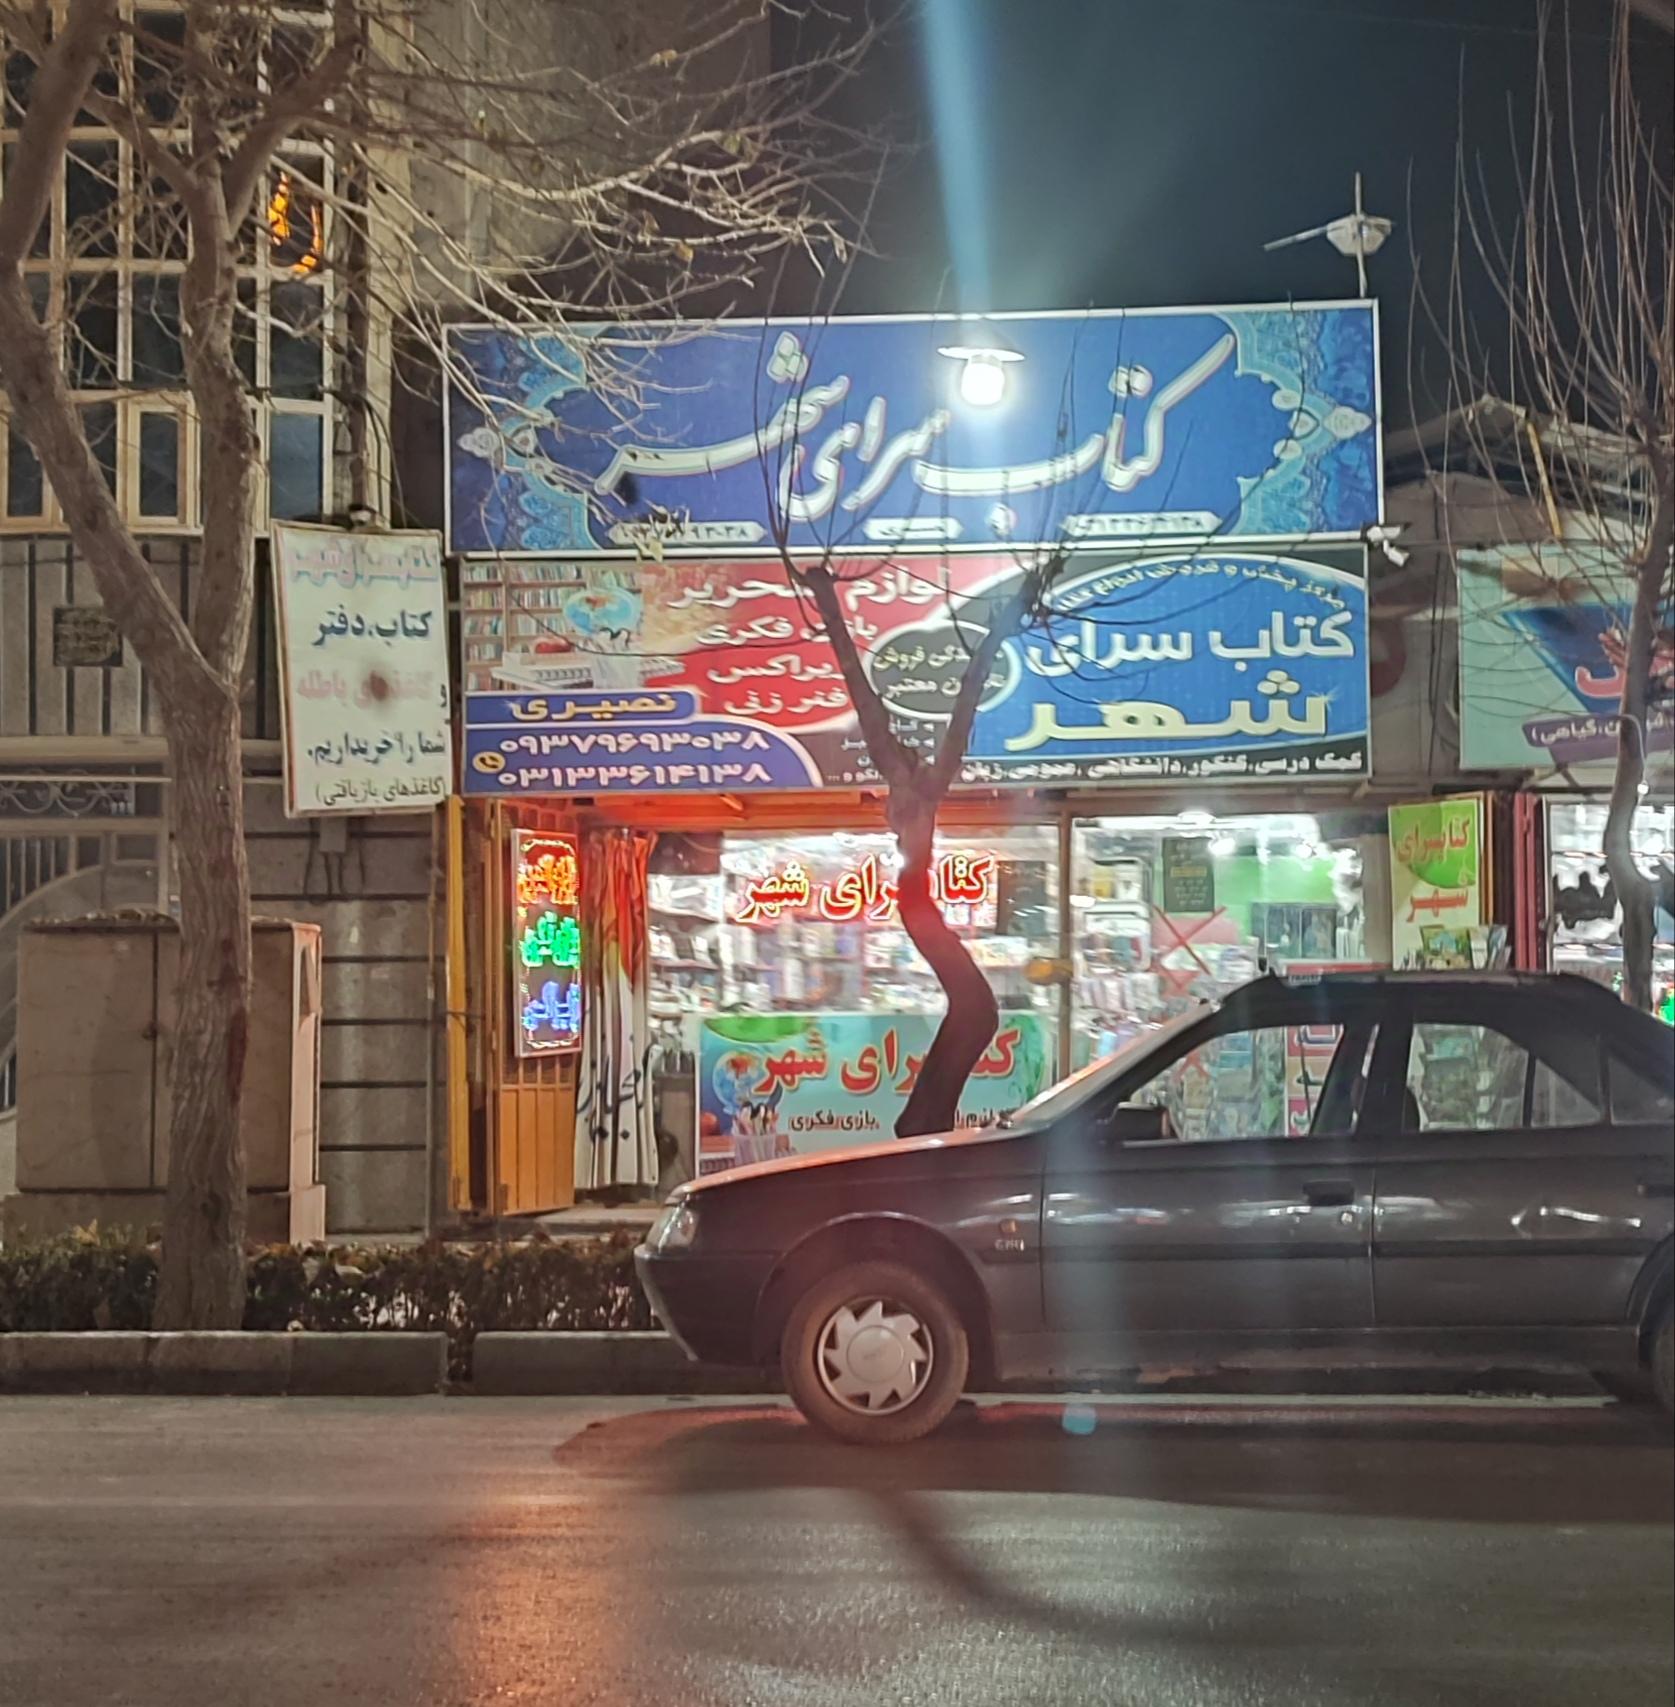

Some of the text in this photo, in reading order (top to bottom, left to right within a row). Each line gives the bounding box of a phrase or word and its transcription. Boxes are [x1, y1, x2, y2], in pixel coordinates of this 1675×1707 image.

[594, 330, 1237, 537] کتاب سرای شهر
[667, 566, 949, 612] لوازم حریر
[311, 603, 364, 646] دفتر
[695, 616, 794, 645] فکری
[1024, 611, 1354, 677] کتاب سرای
[510, 693, 677, 721] نصیری
[723, 687, 849, 716] فنر زنی
[1004, 670, 1327, 751] شهر
[420, 729, 446, 754] شما
[500, 732, 771, 755] ۰۹۳۷۹۶۹۳۰۳۸
[499, 763, 772, 788] ۰۳۱۳۳۶۱۴۱۳۸
[1315, 752, 1362, 771] کمک
[1395, 817, 1470, 864] کتابسرای
[736, 861, 811, 923] شهر
[752, 1026, 827, 1094] شهر
[789, 1109, 835, 1131] فکری
